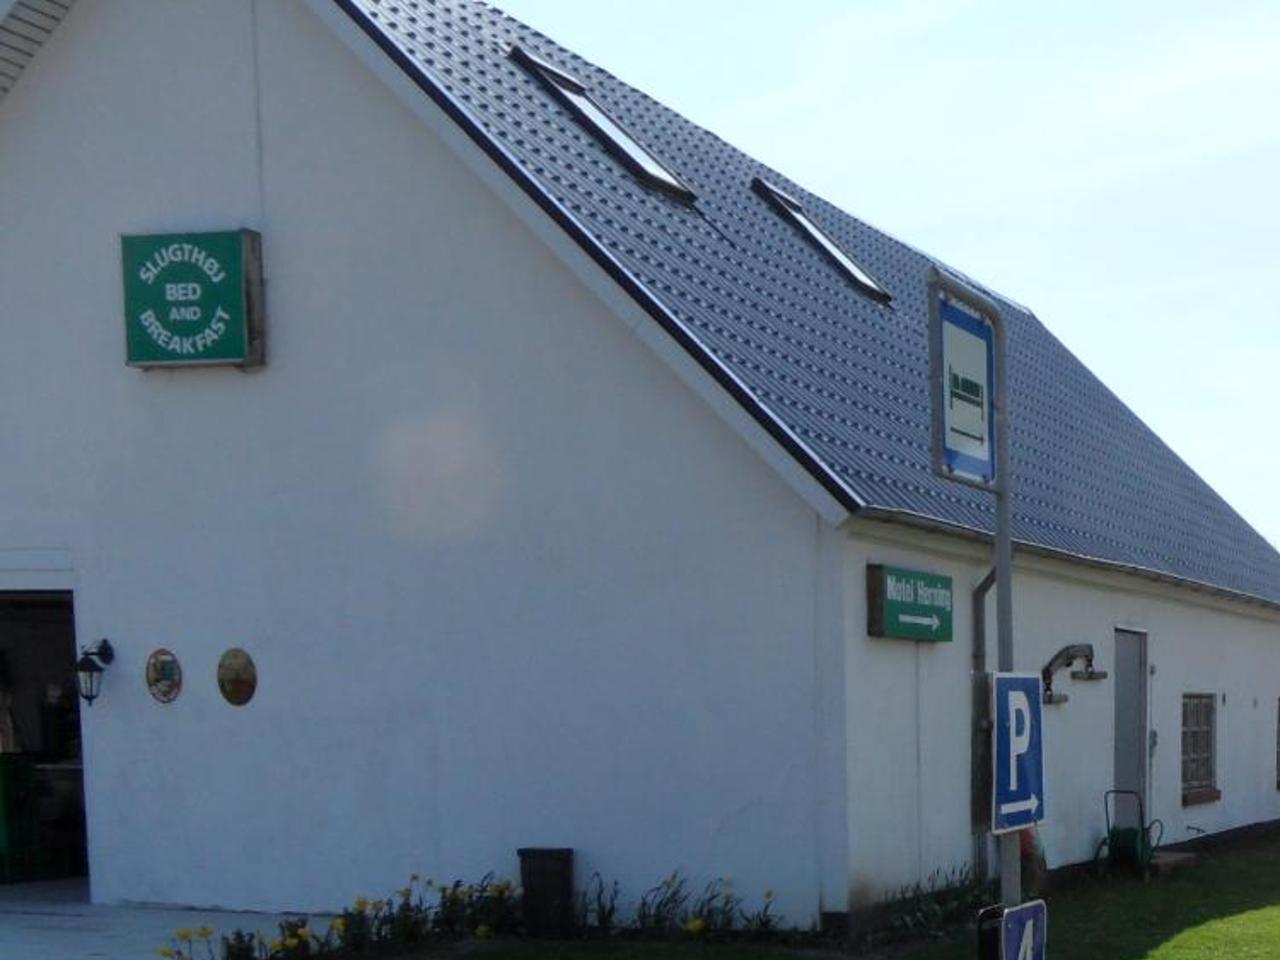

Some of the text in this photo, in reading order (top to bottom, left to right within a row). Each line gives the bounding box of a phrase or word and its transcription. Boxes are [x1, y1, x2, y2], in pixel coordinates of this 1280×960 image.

[165, 283, 202, 301] BED
[139, 305, 231, 354] BREAKFAST
[169, 306, 201, 321] AND
[1008, 690, 1031, 791] P
